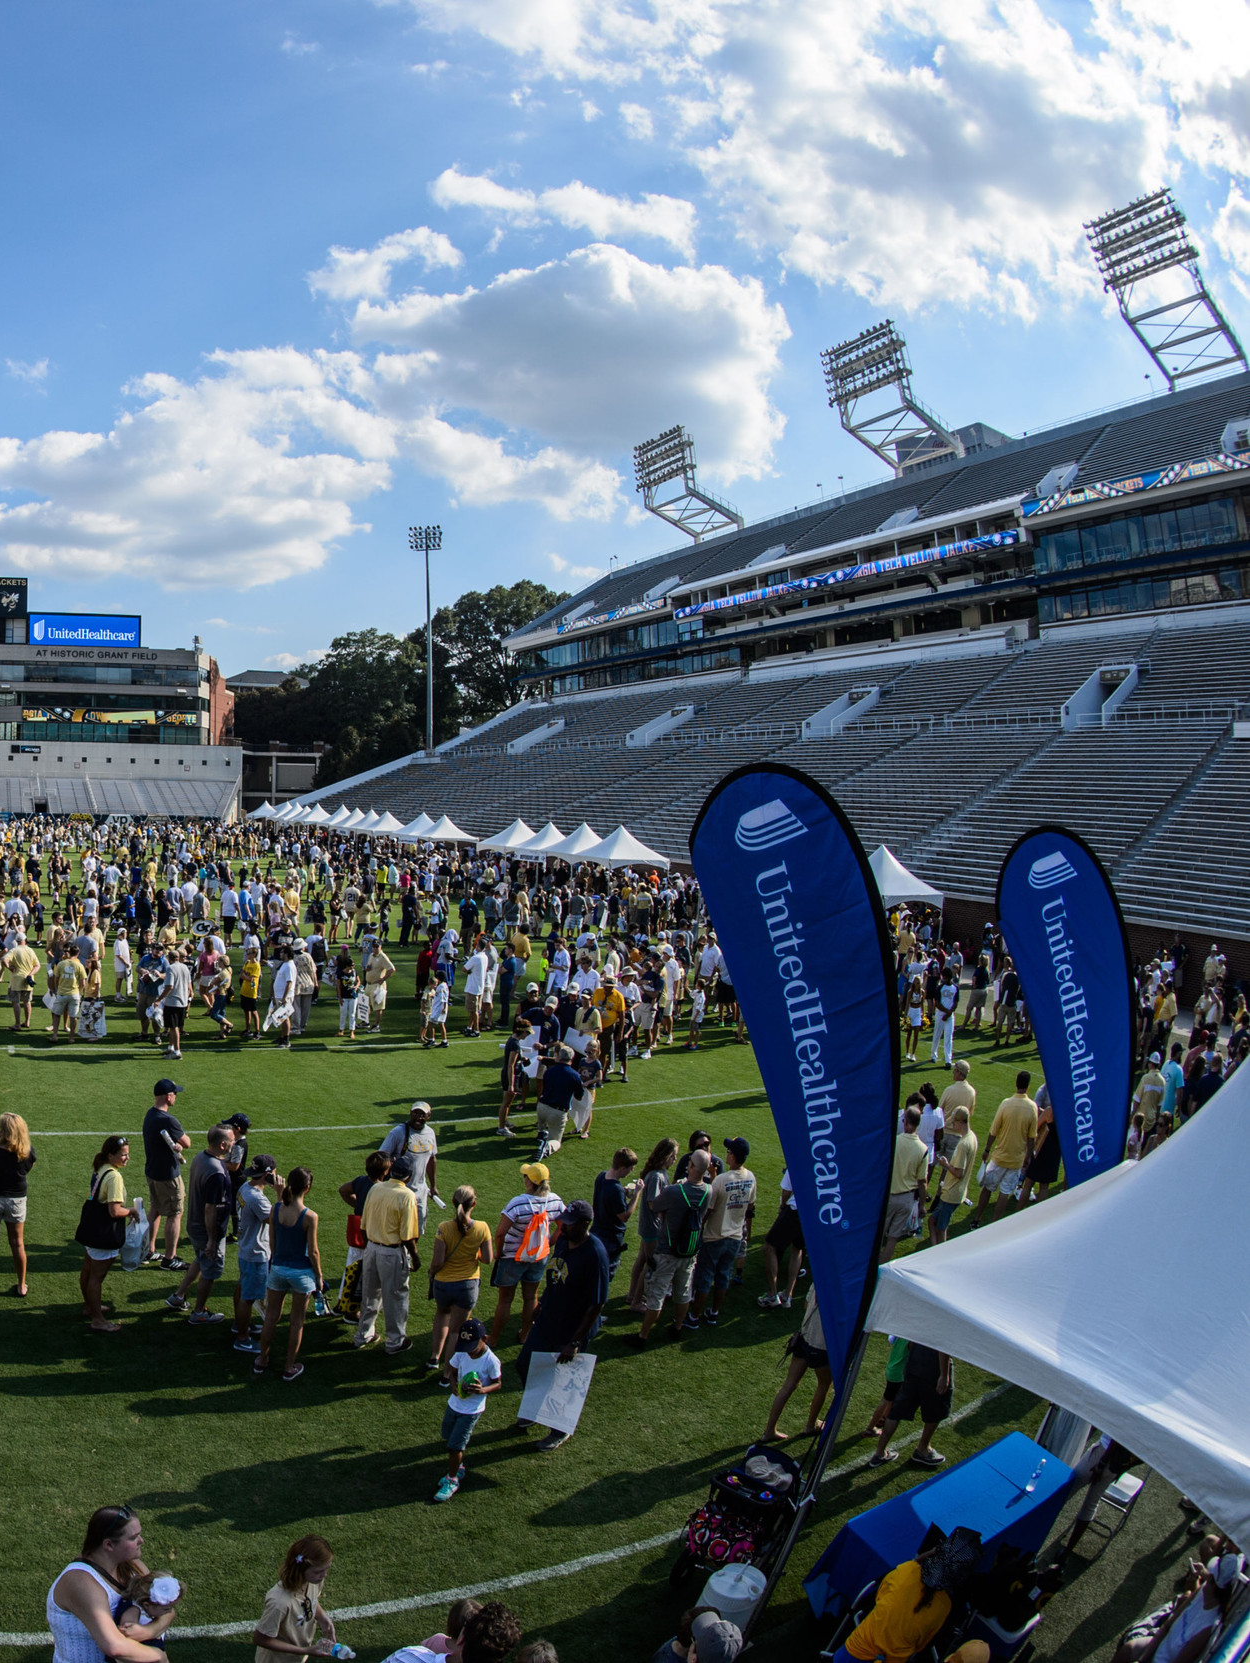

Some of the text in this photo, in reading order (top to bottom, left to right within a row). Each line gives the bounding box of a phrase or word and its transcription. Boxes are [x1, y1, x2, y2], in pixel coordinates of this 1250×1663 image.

[903, 547, 942, 566] YELLOW
[48, 627, 136, 641] UnitedHealthcare
[50, 650, 95, 659] HISTORIC
[97, 651, 129, 660] GRANT
[131, 652, 158, 661] FIELD
[1041, 898, 1096, 1165] UnitedHealthcare
[754, 859, 843, 1227] UnitedHealthcare
